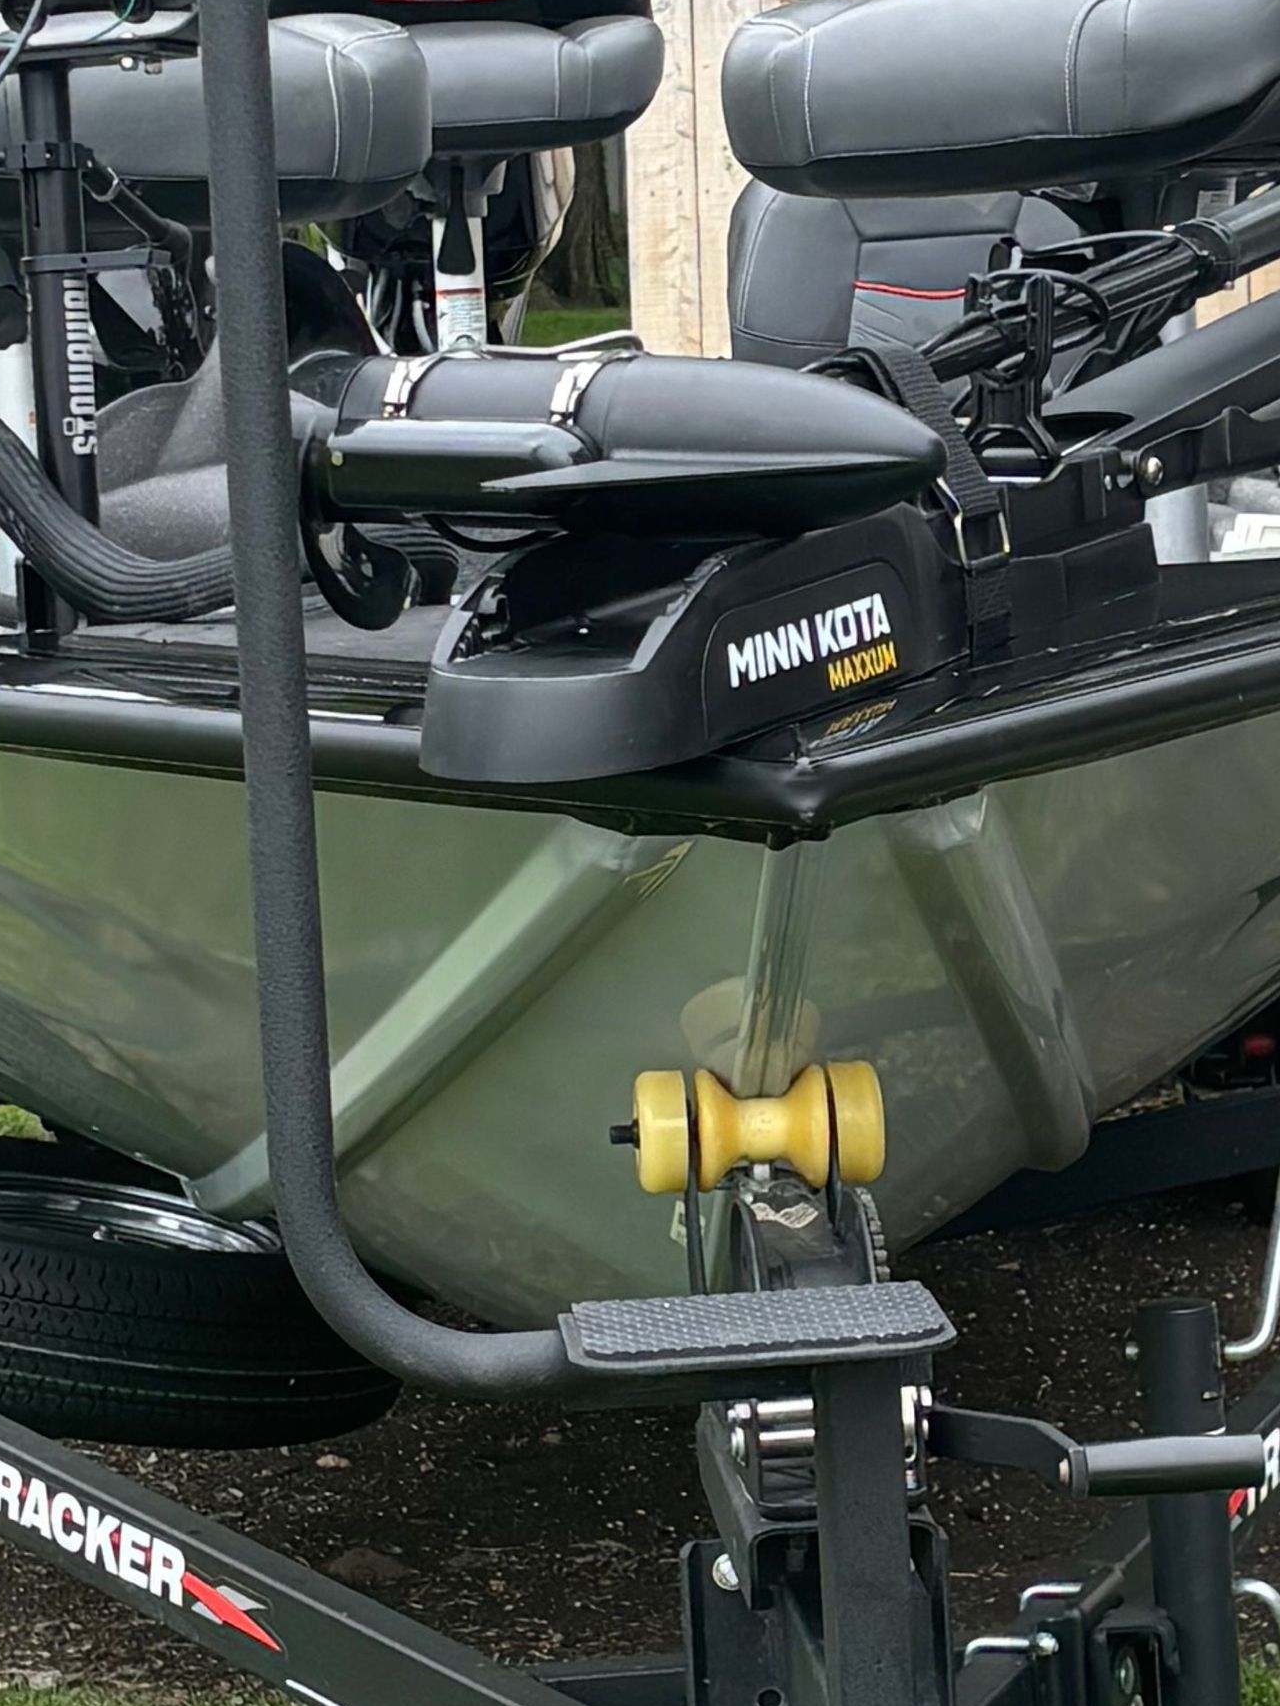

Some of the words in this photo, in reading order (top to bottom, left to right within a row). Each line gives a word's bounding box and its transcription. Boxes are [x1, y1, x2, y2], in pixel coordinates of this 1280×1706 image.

[727, 618, 814, 688] MINN
[814, 593, 891, 658] KOTA
[827, 641, 897, 691] MAXXUM
